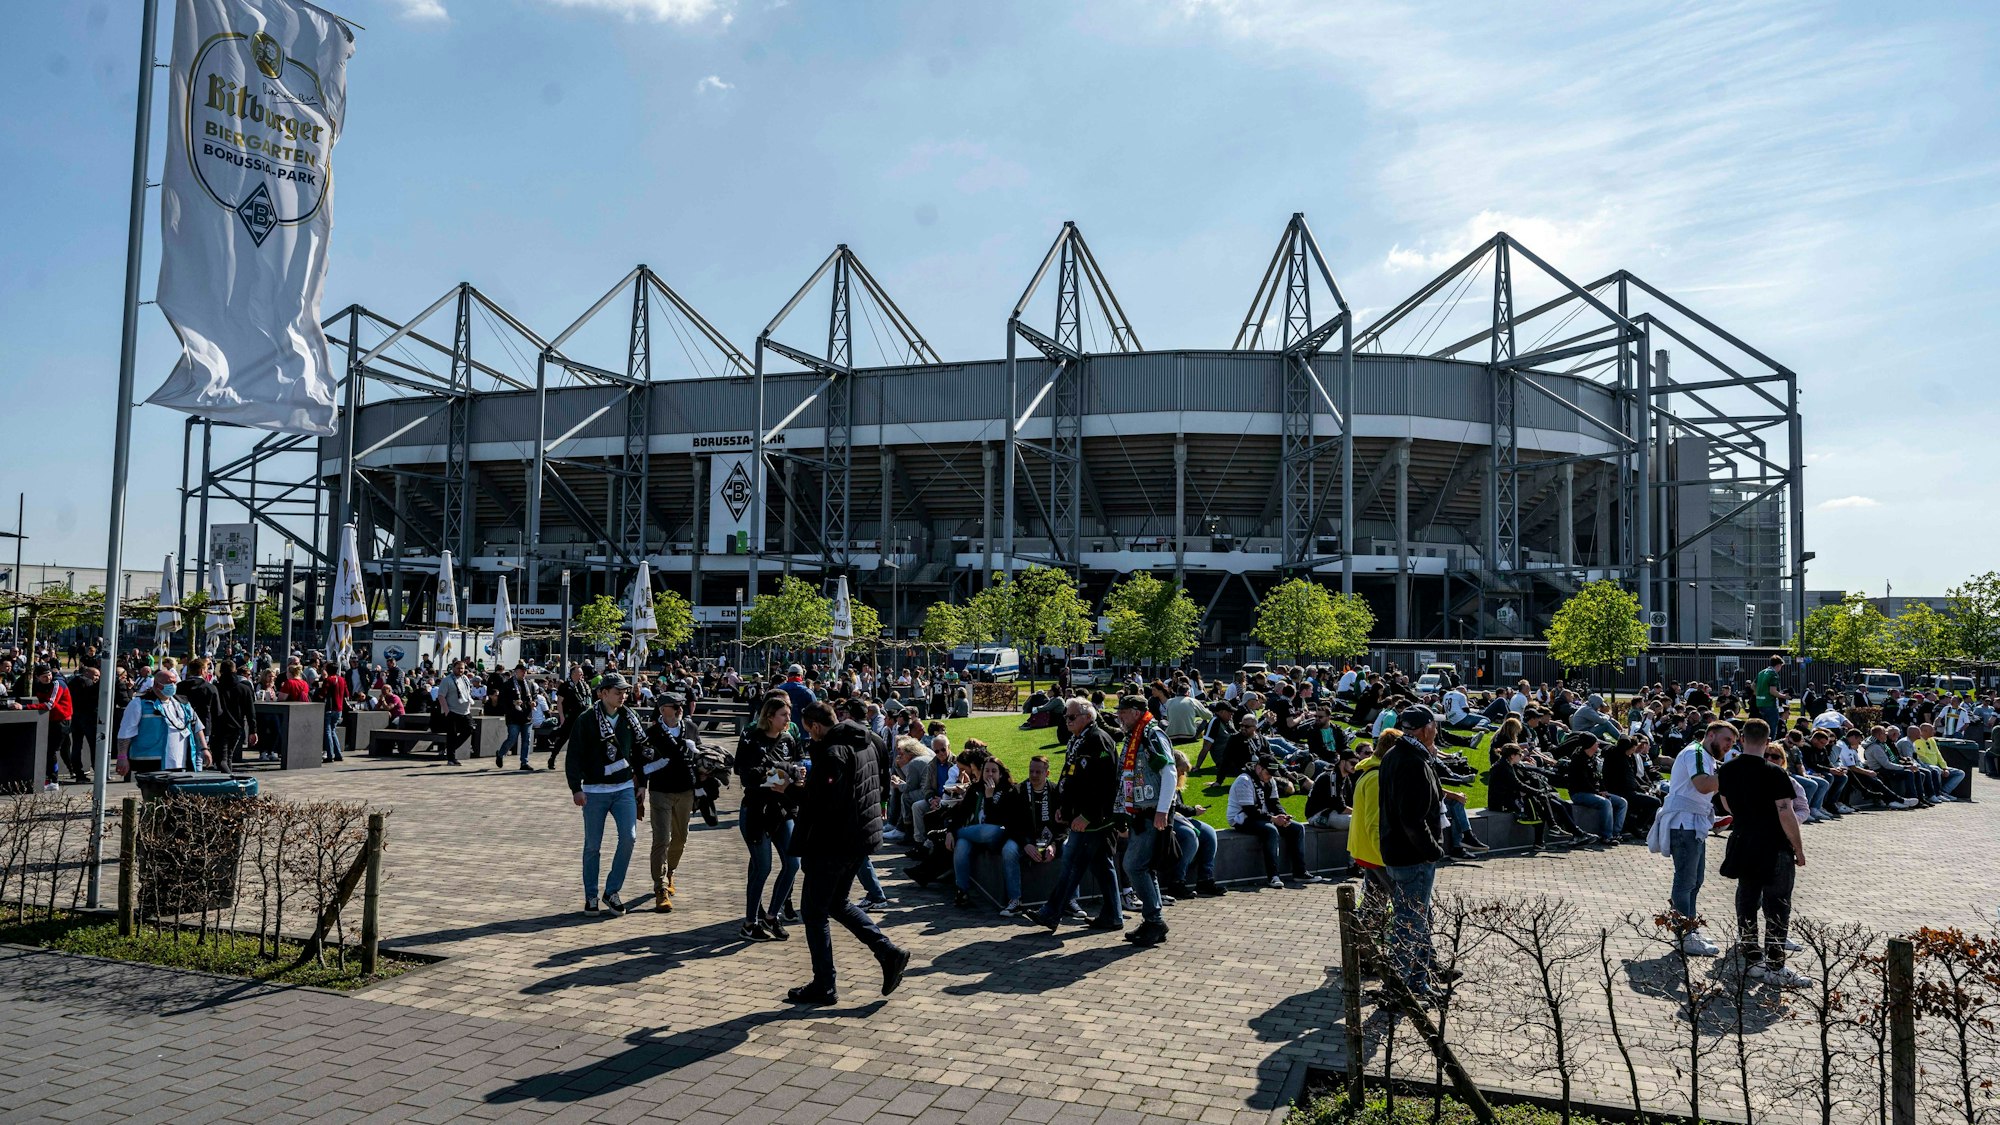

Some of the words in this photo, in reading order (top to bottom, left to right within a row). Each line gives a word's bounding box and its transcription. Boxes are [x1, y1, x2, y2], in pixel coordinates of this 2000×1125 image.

[204, 72, 324, 145] Bitburger
[203, 143, 316, 187] BORUSSIA-PARK
[205, 120, 316, 168] BIERGARTEN
